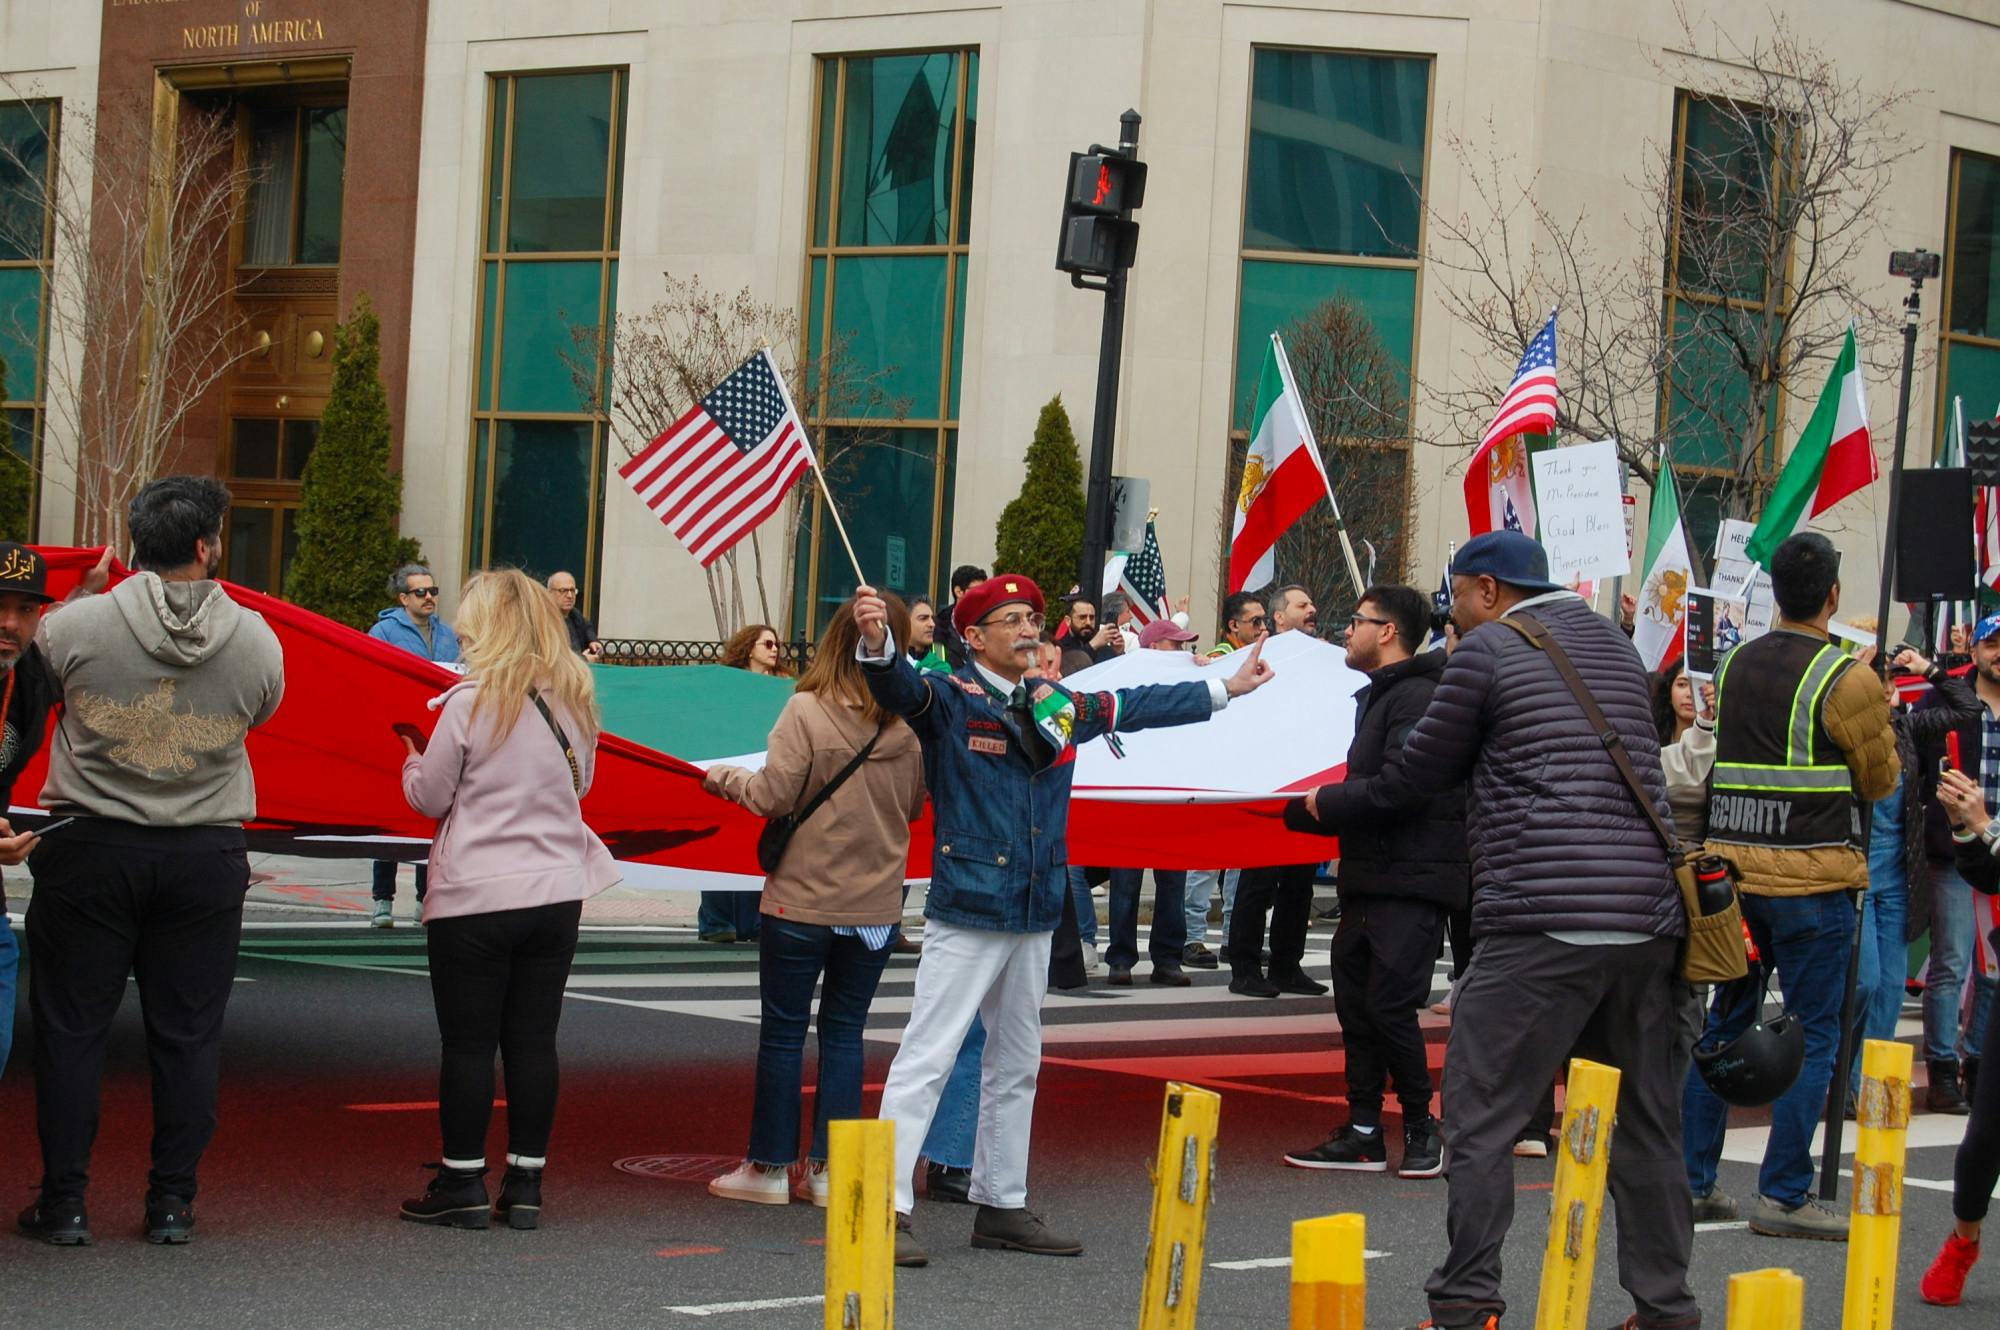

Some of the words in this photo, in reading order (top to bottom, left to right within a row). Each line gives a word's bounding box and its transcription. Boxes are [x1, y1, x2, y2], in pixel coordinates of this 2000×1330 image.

[245, 0, 264, 17] OF
[183, 24, 239, 49] NORTH
[249, 18, 325, 45] AMERICA
[1544, 459, 1572, 476] Thank
[1547, 514, 1576, 538] God
[1585, 514, 1610, 533] Bless
[1552, 545, 1600, 573] America
[1718, 572, 1745, 585] THANKS
[972, 739, 1005, 752] KILLED
[1709, 794, 1792, 835] SECURITY
